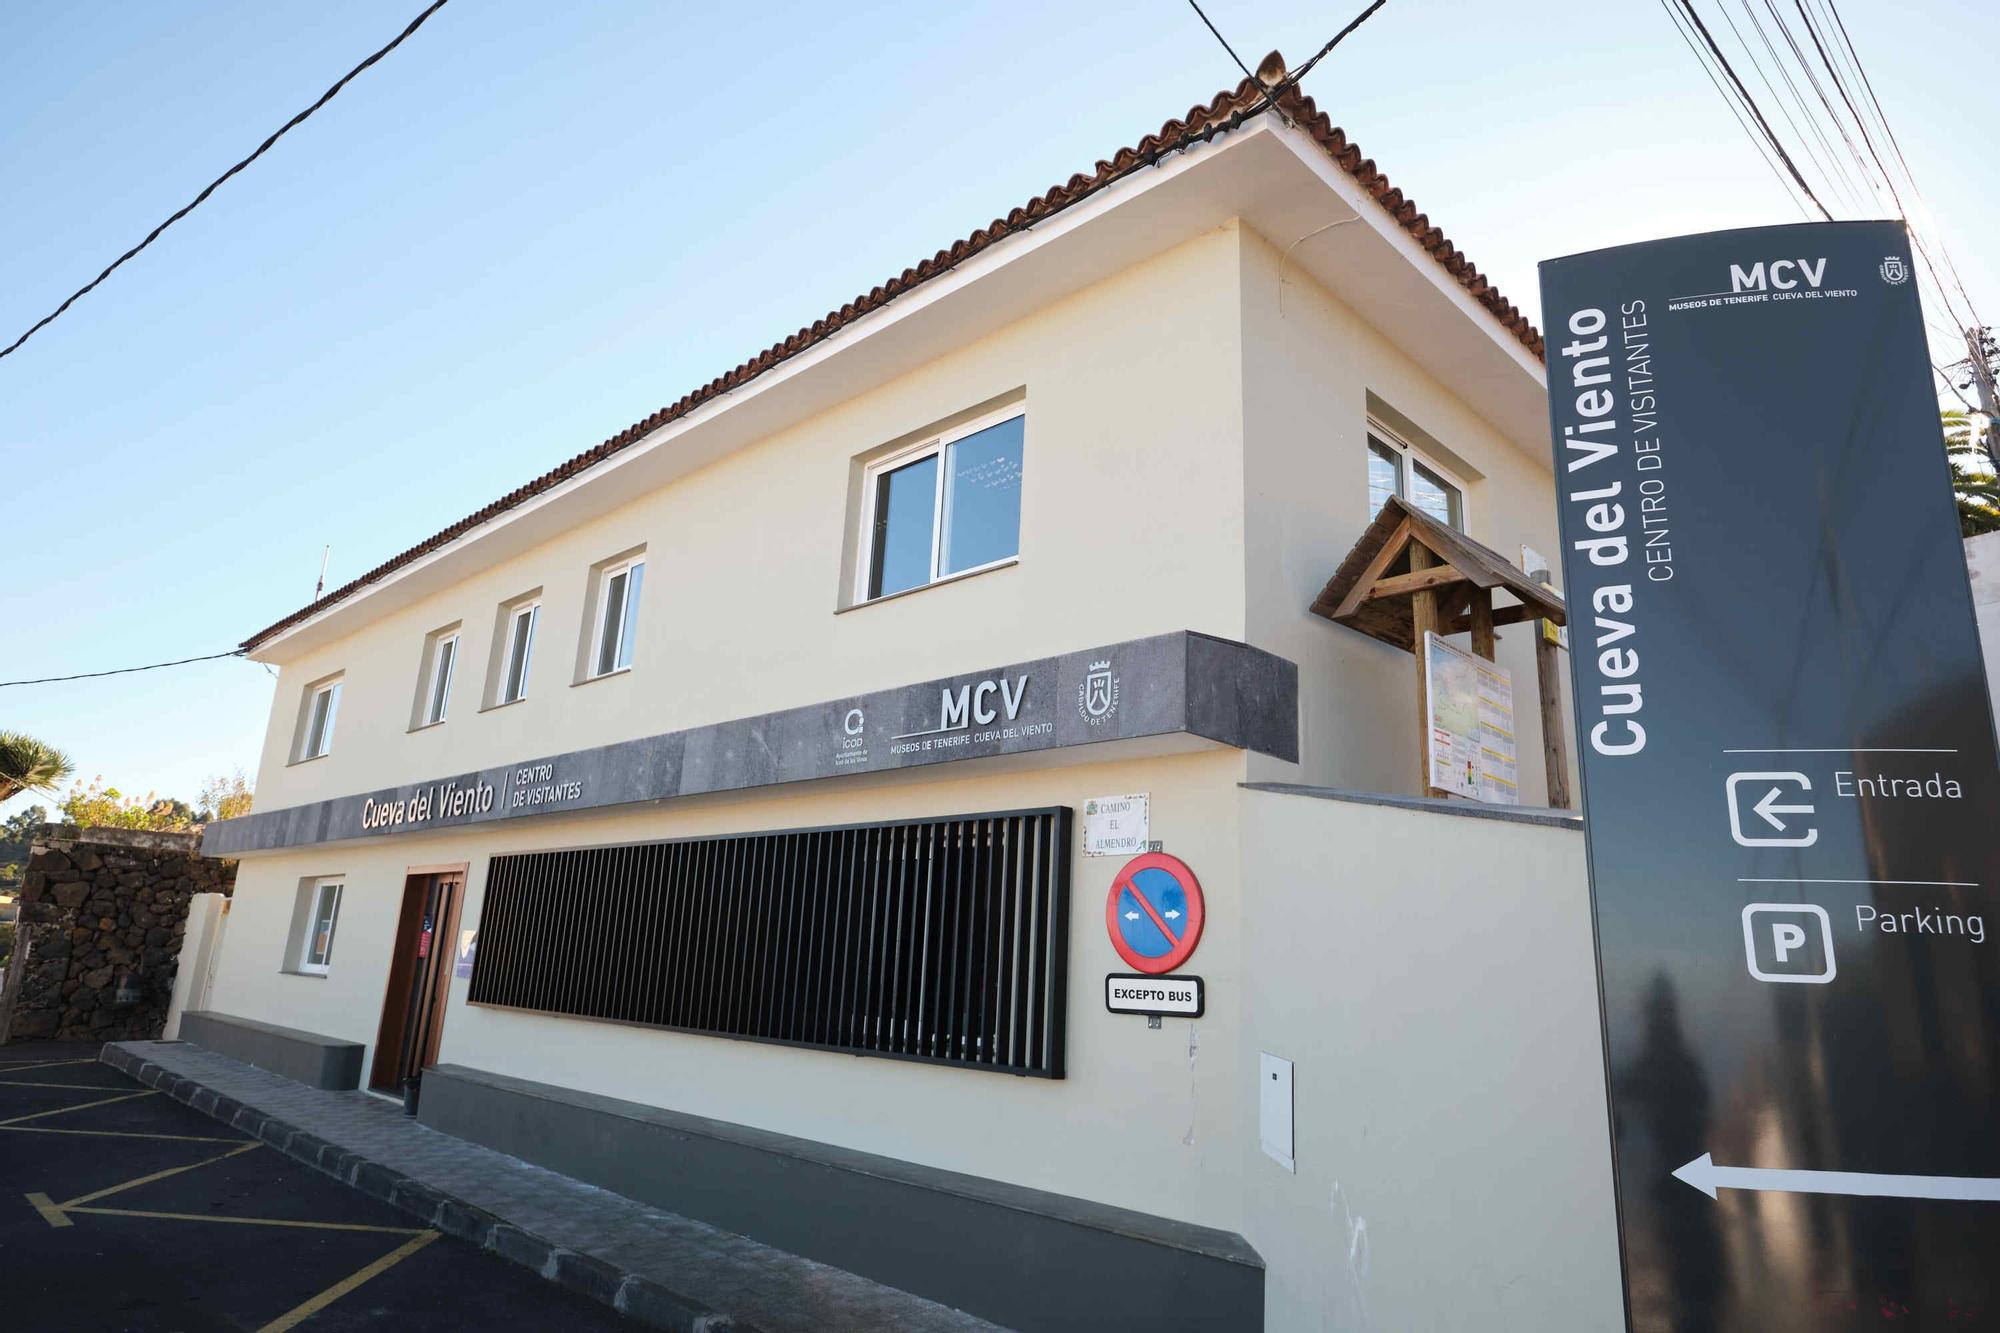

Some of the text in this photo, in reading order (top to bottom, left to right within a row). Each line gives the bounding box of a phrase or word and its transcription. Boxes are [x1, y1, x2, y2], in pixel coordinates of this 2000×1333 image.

[1730, 258, 1826, 292] MCV
[1668, 300, 1707, 311] MUSEOS
[1724, 294, 1768, 304] TENERIFE
[1772, 292, 1803, 300] CUEVA
[1806, 290, 1823, 298] DEL
[1824, 289, 1858, 298] VIENTO
[1621, 300, 1674, 582] CENTRO DE VISITANTES
[1561, 307, 1646, 756] Cueva del Viento
[941, 676, 1028, 730] MCV
[1078, 678, 1120, 726] CABILDO DE TENERIFE
[890, 722, 1053, 754] MUSEOS DE TENERIFE CUEVA DEL VIENTO
[516, 764, 553, 786] CENTRO
[1834, 771, 1962, 798] Entrada
[362, 779, 494, 830] Cueva del Viento
[513, 781, 582, 808] DE VISITANTES
[1100, 801, 1131, 814] CAMINO
[1110, 820, 1119, 830] EL
[1095, 836, 1137, 850] ALMENDRO
[1856, 904, 1985, 944] Parking
[1772, 923, 1806, 962] P
[1114, 988, 1192, 1002] EXCEPTO BUS
